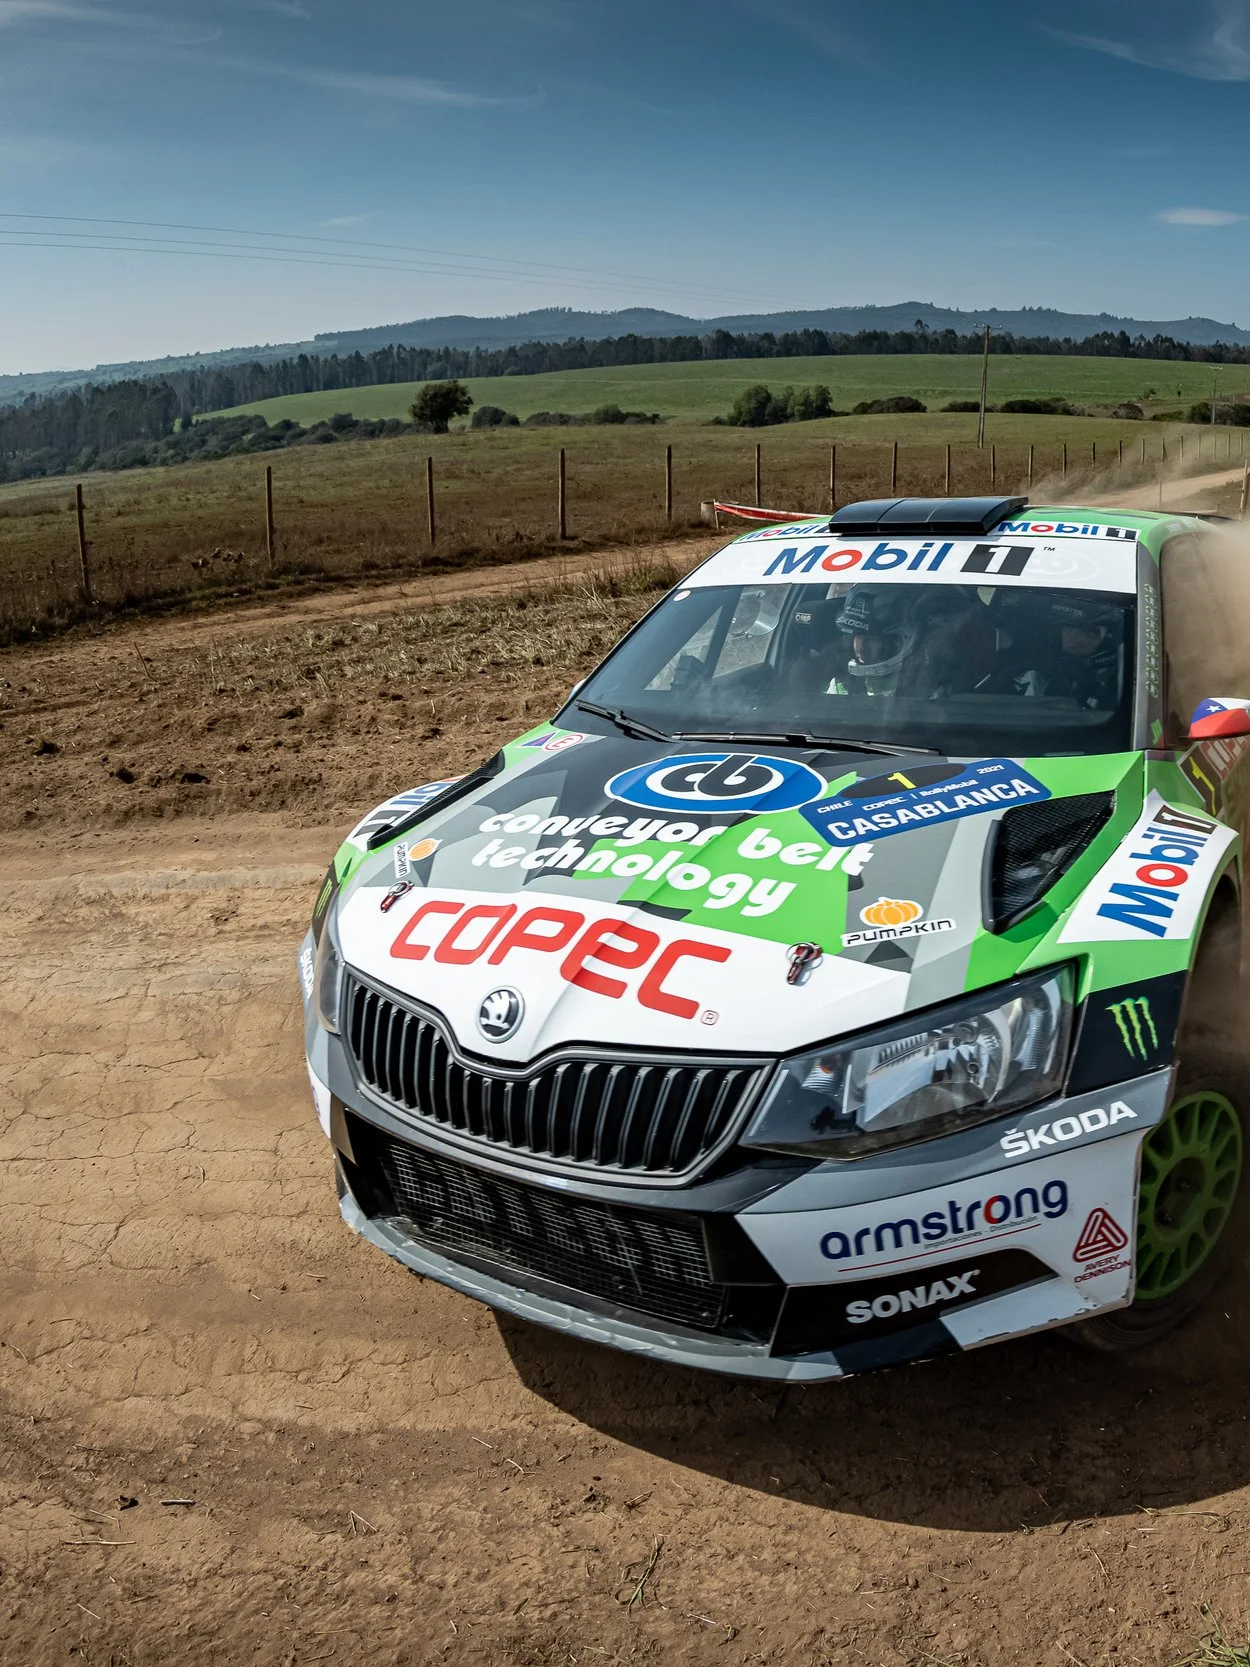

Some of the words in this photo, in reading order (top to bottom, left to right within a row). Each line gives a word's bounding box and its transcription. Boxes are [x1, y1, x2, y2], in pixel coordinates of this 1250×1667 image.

[740, 525, 820, 541] Mobil
[997, 522, 1099, 536] Mobil
[762, 543, 954, 577] Mobil
[887, 771, 917, 790] 1
[976, 764, 1005, 775] 2021
[817, 800, 854, 814] CHILE
[827, 778, 1040, 840] CASABLANCA
[862, 797, 908, 811] COPEC
[919, 779, 979, 797] RallyMobil
[479, 812, 728, 848] conveyor
[737, 828, 875, 876] belt
[471, 839, 798, 917] technology
[1097, 827, 1209, 938] Mobil
[1000, 1101, 1138, 1158] ŠKODA
[820, 1179, 1068, 1260] armstrong
[924, 1230, 983, 1250] Importaciones
[1074, 1259, 1132, 1283] DENNISON
[1084, 1254, 1121, 1273] AVERY
[845, 1269, 976, 1324] SONAX
